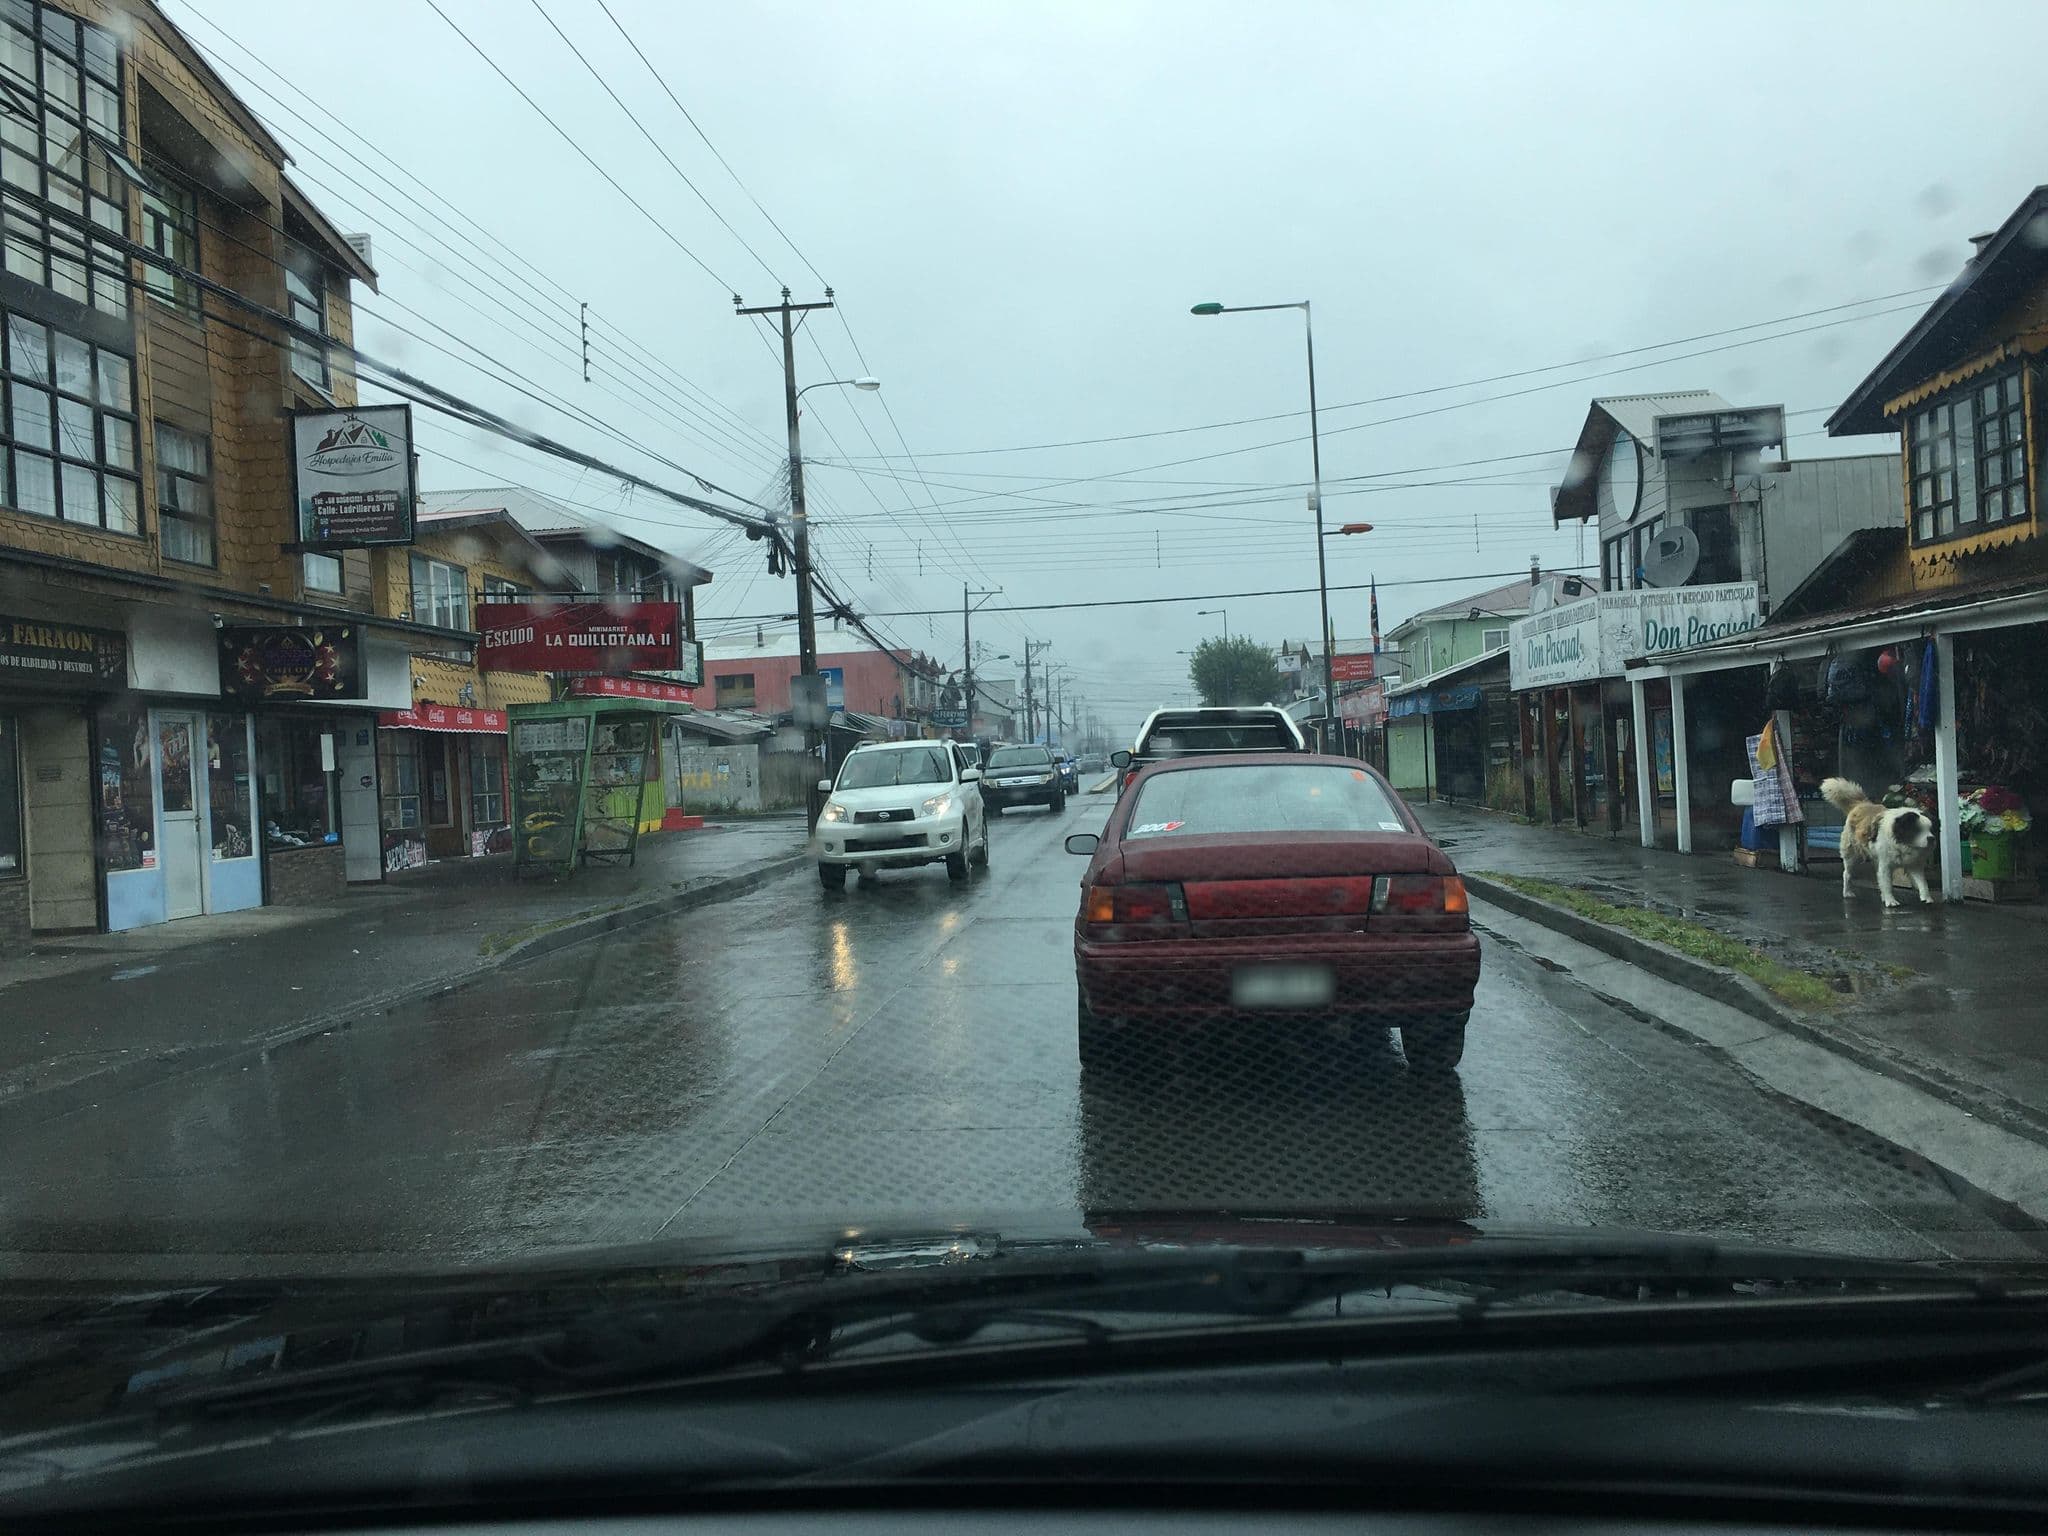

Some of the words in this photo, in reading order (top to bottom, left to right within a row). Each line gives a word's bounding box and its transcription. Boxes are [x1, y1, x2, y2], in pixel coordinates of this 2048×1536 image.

[362, 451, 393, 463] Emilia
[317, 506, 338, 515] Calle:
[340, 504, 380, 514] Ladrilleros
[382, 502, 395, 512] 715
[1676, 592, 1681, 604] Y
[1682, 590, 1714, 604] MERCADO
[1715, 586, 1756, 602] PARTICULAR
[485, 626, 534, 648] ESCUDO
[545, 633, 563, 647] LA
[568, 633, 656, 647] QUILLOTANA
[661, 633, 671, 646] II
[1645, 618, 1683, 651] Don
[1528, 639, 1544, 670] Don
[1546, 628, 1580, 666] Pascual
[10, 656, 20, 667] DE
[21, 657, 57, 670] HABILIDAD
[58, 660, 62, 671] Y
[64, 661, 93, 673] DESTREZA
